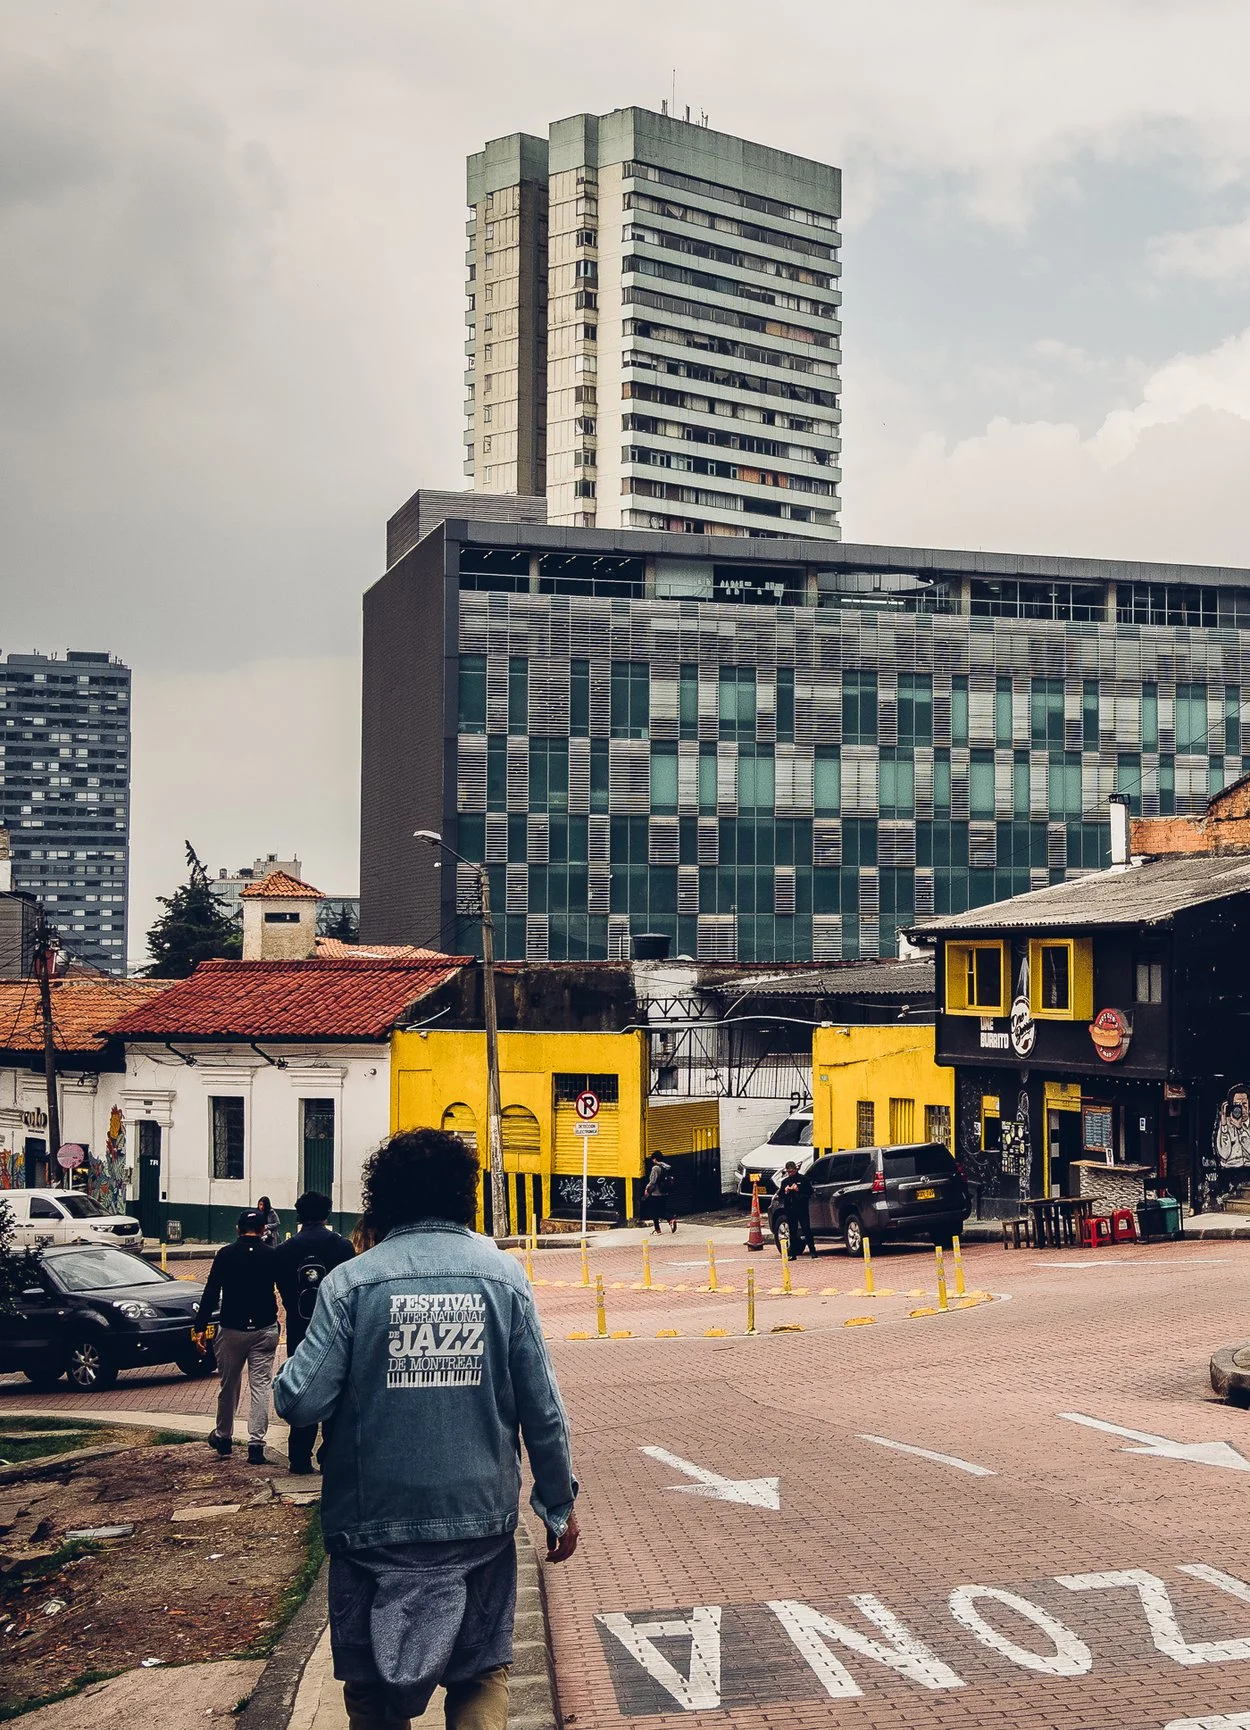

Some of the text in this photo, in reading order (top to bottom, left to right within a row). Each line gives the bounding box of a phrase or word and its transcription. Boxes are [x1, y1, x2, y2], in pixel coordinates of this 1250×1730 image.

[980, 1032, 1009, 1049] BURRITO
[389, 1293, 486, 1312] FESTIVAL
[389, 1310, 486, 1325] INTERNATIONAL
[388, 1323, 485, 1357] DE JAZZ
[387, 1356, 483, 1372] DE MONTREAL
